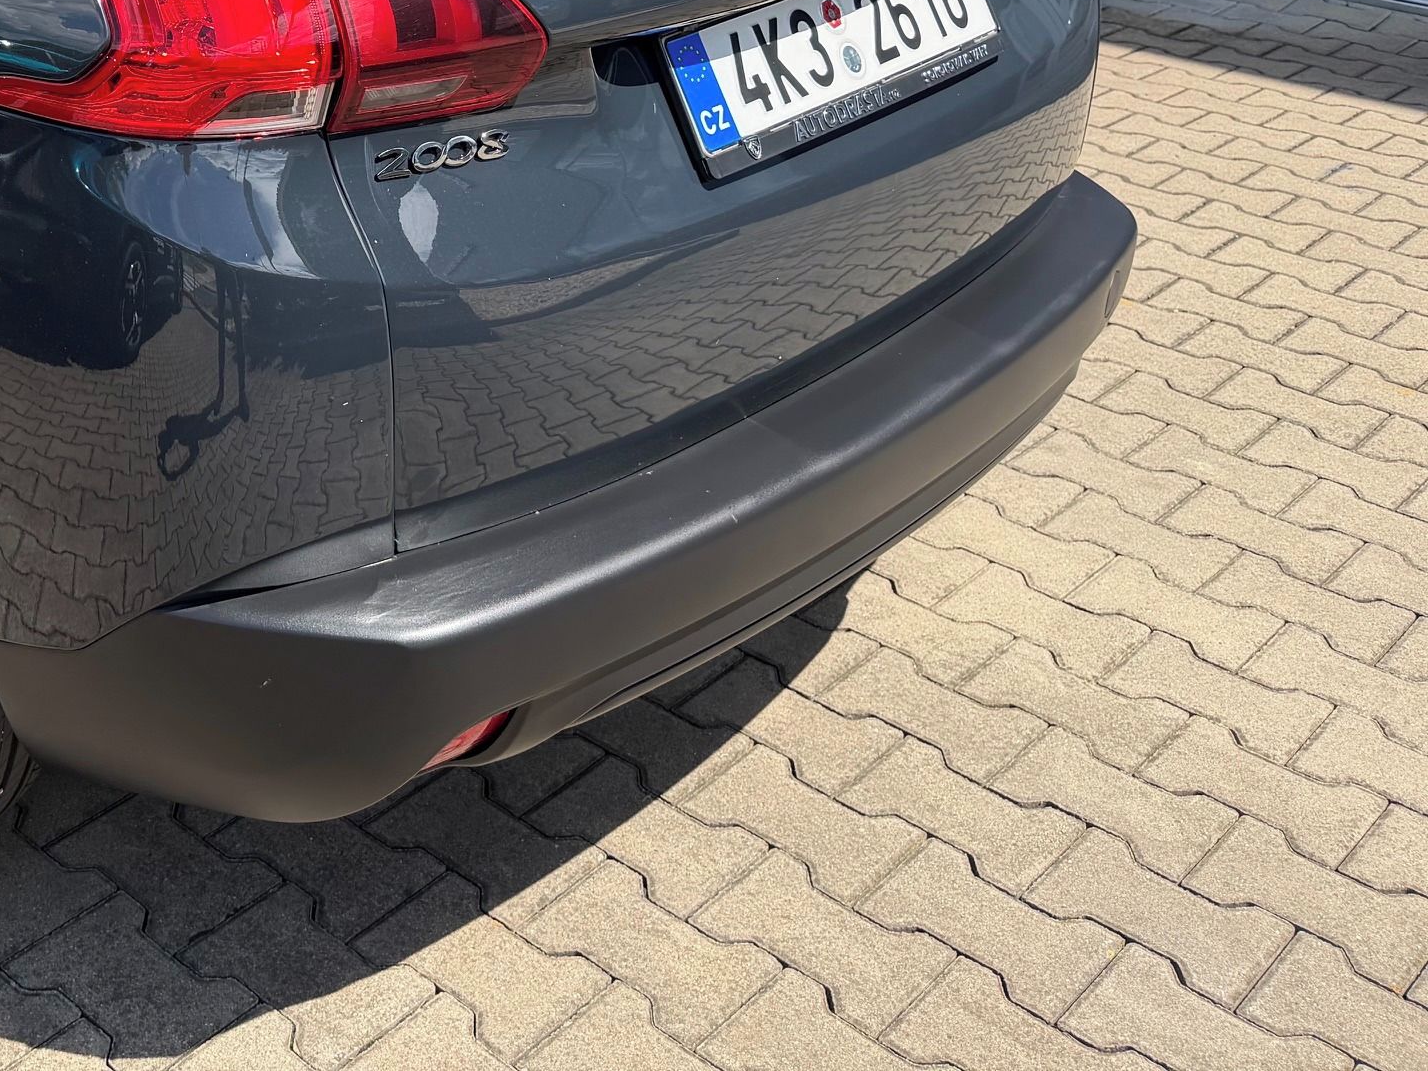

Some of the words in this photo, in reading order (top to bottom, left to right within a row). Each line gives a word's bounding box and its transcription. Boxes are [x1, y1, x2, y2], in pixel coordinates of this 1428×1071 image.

[729, 9, 834, 112] 4K3
[699, 104, 731, 135] CZ
[375, 129, 510, 181] 2008
